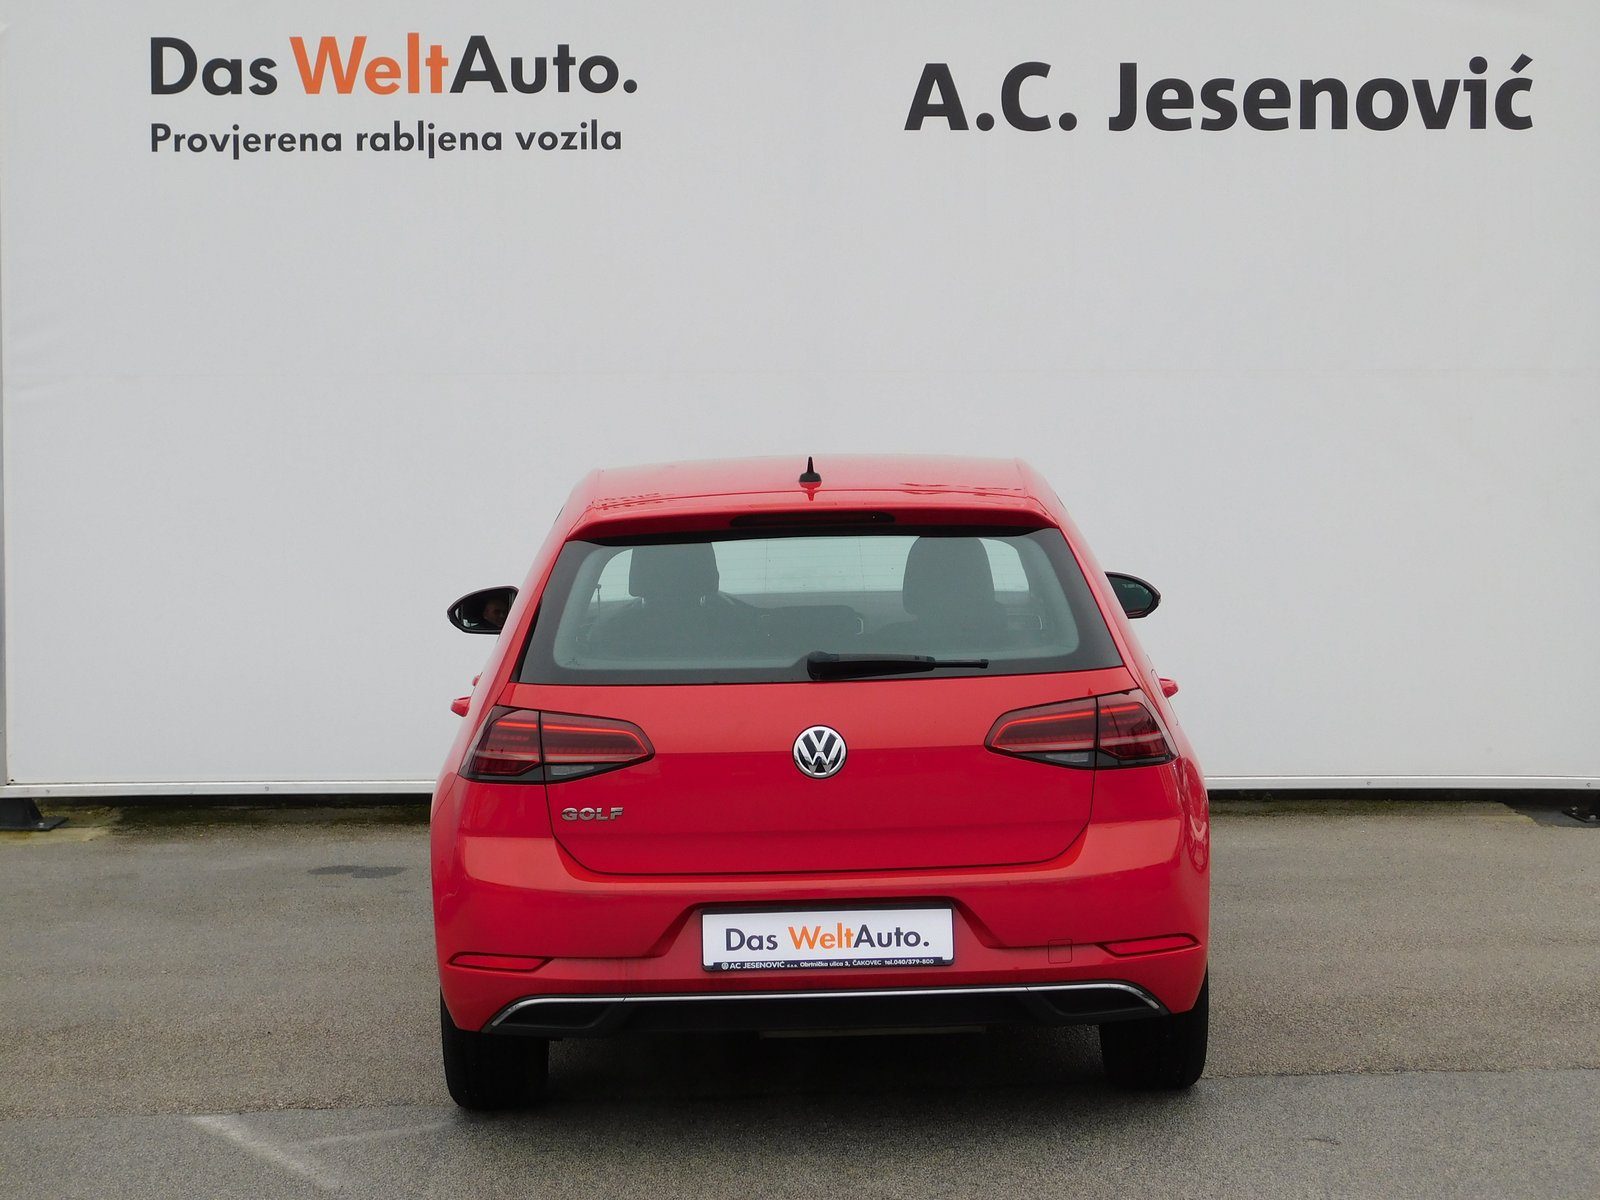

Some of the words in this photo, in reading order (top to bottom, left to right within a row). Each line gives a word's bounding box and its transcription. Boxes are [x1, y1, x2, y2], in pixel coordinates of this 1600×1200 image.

[151, 37, 277, 96] Das
[290, 33, 638, 96] WeltAuto.
[904, 62, 1077, 131] A.C.
[1109, 53, 1533, 131] Jesenović
[151, 123, 341, 160] Provjerena
[357, 120, 501, 159] rabljena
[515, 119, 621, 151] vozila
[561, 807, 624, 821] GOLF
[725, 927, 779, 952] Das
[788, 922, 930, 950] WeltAuto.
[729, 962, 742, 970] AC
